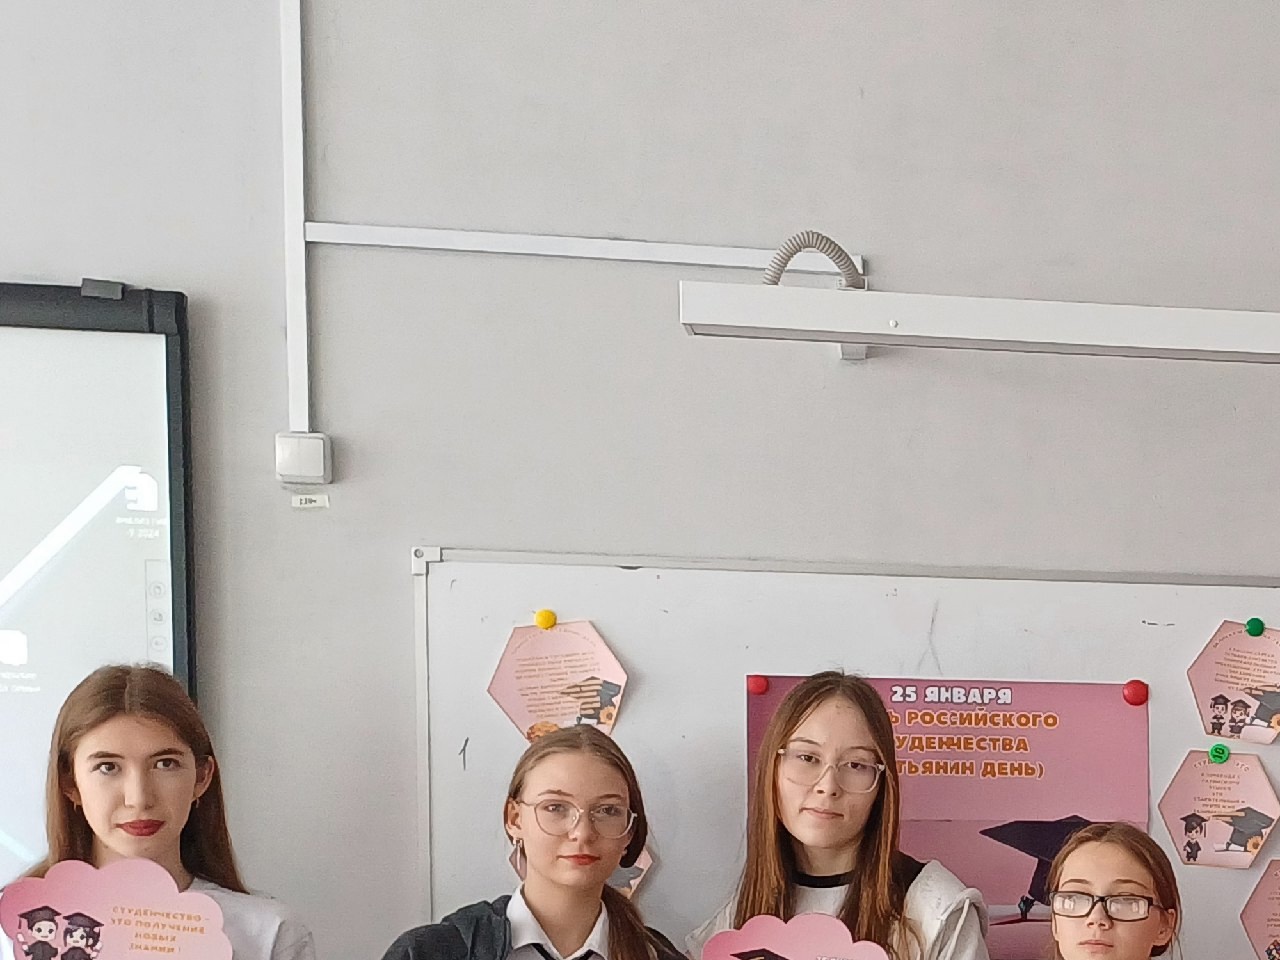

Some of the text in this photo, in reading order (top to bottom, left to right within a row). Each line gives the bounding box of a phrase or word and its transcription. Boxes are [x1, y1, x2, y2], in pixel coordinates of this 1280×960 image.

[891, 685, 1013, 704] 25 ЯНВАРЯ
[906, 706, 1060, 728] РОССИЙСКОГО
[895, 735, 1030, 752] УДЕНЧЕСТВА
[898, 759, 1045, 779] ТЬЯНИН ДЕНЬ)
